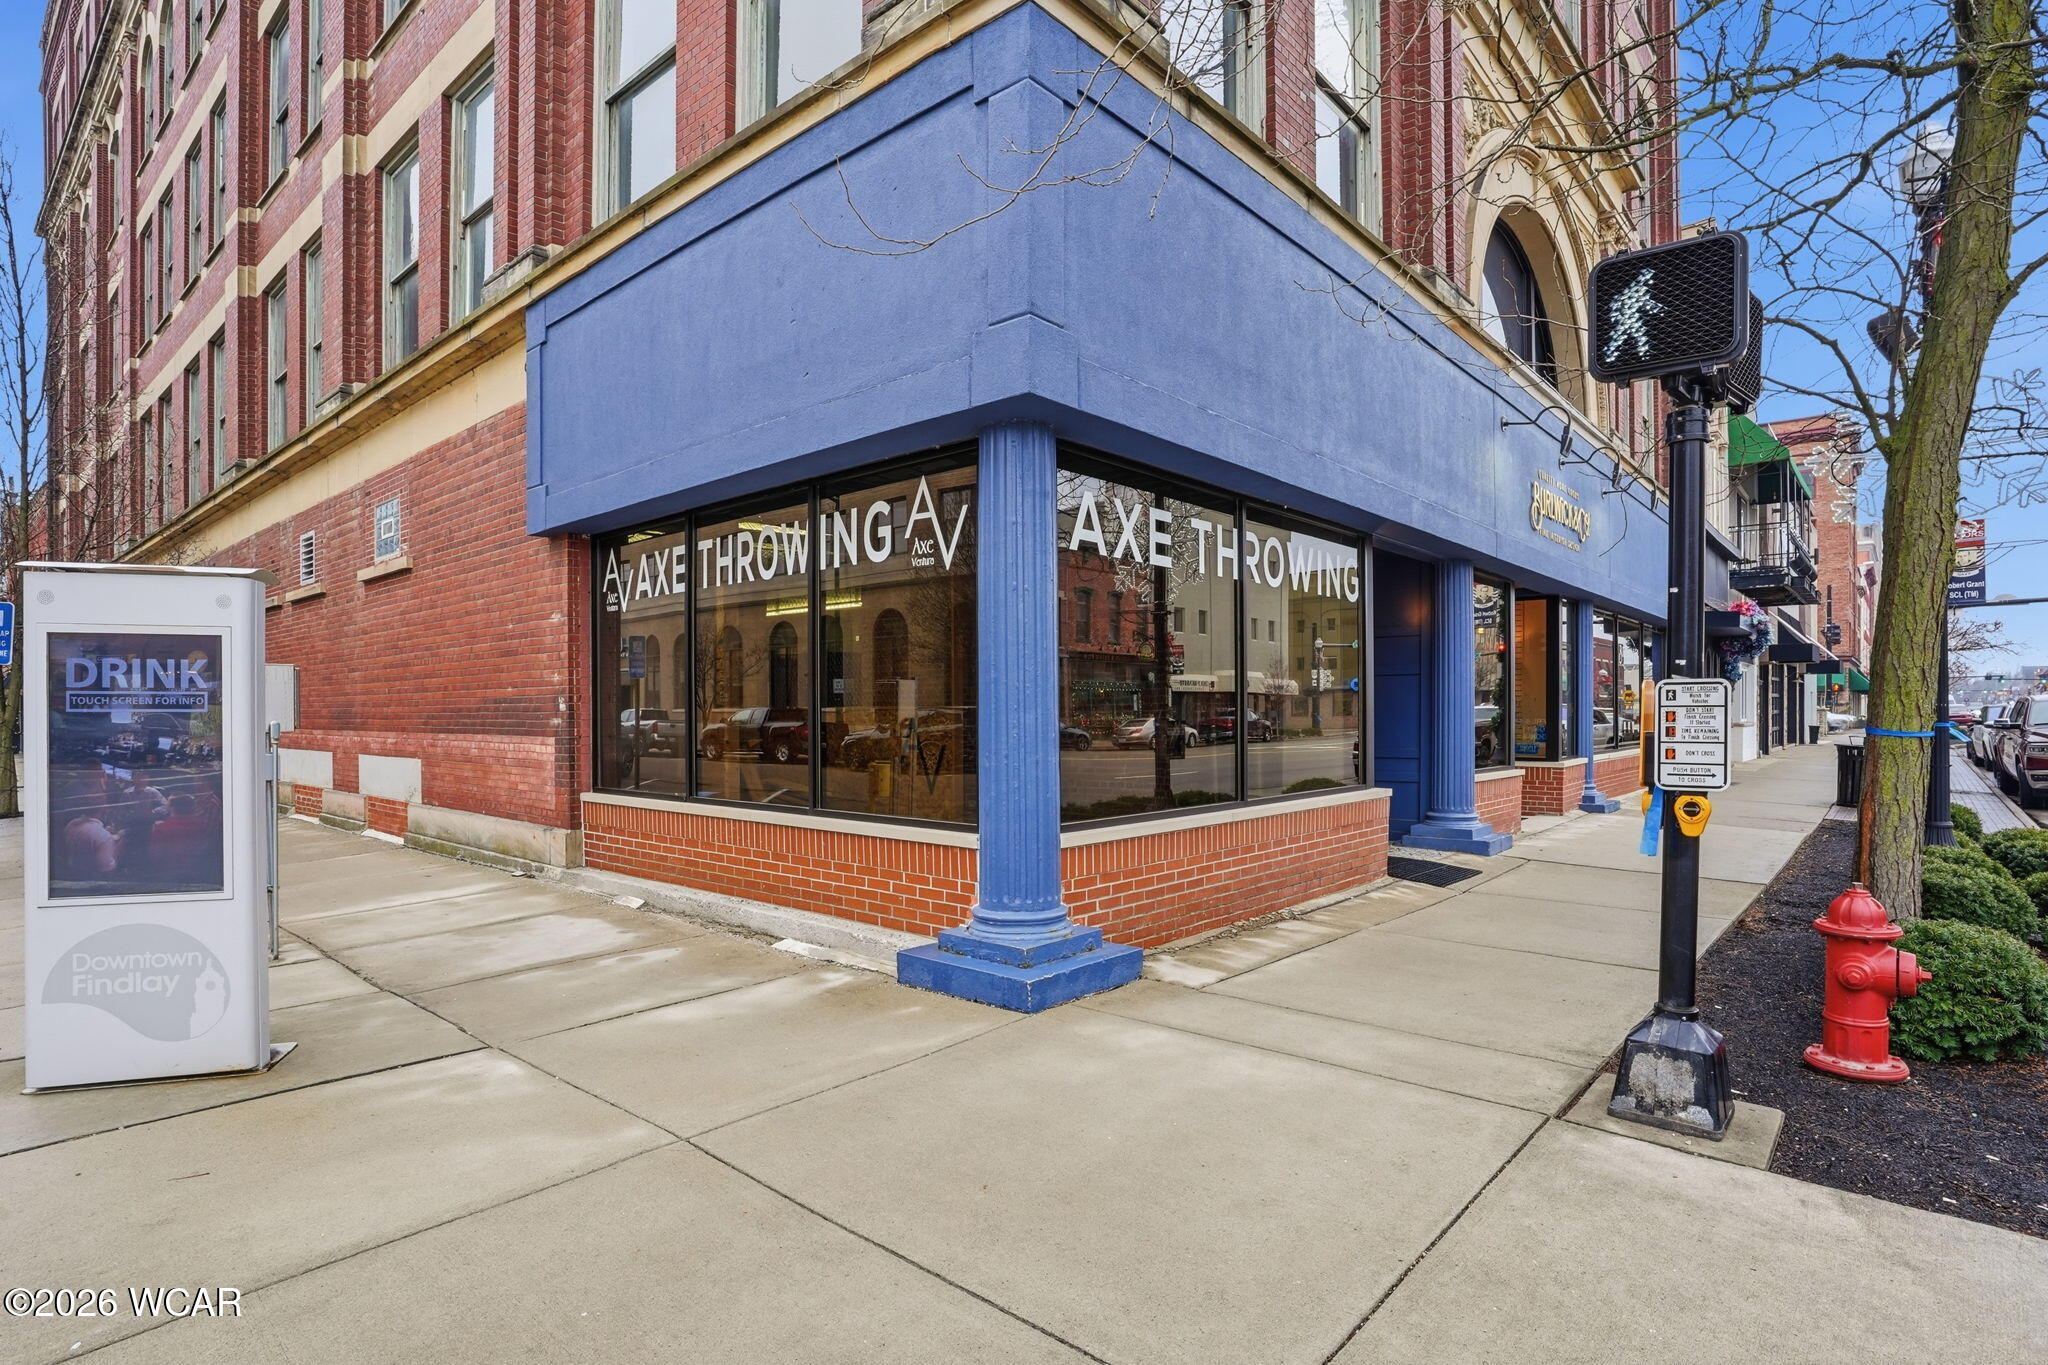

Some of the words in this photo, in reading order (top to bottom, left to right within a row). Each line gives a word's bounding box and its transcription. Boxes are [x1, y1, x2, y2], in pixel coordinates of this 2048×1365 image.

[635, 544, 686, 600] AXE
[698, 500, 892, 589] THROWING
[912, 537, 934, 555] Axe
[1069, 490, 1172, 568] AXE
[1191, 518, 1359, 603] THROWING
[1964, 590, 1979, 598] (TM)
[1966, 580, 1985, 588] Grant
[66, 658, 207, 689] DRINK
[71, 696, 109, 705] TOUCH
[111, 696, 153, 705] SCREEN
[155, 696, 177, 705] FOR
[179, 696, 205, 705] INFO
[72, 951, 202, 972] Downtown
[72, 971, 180, 997] Findlay
